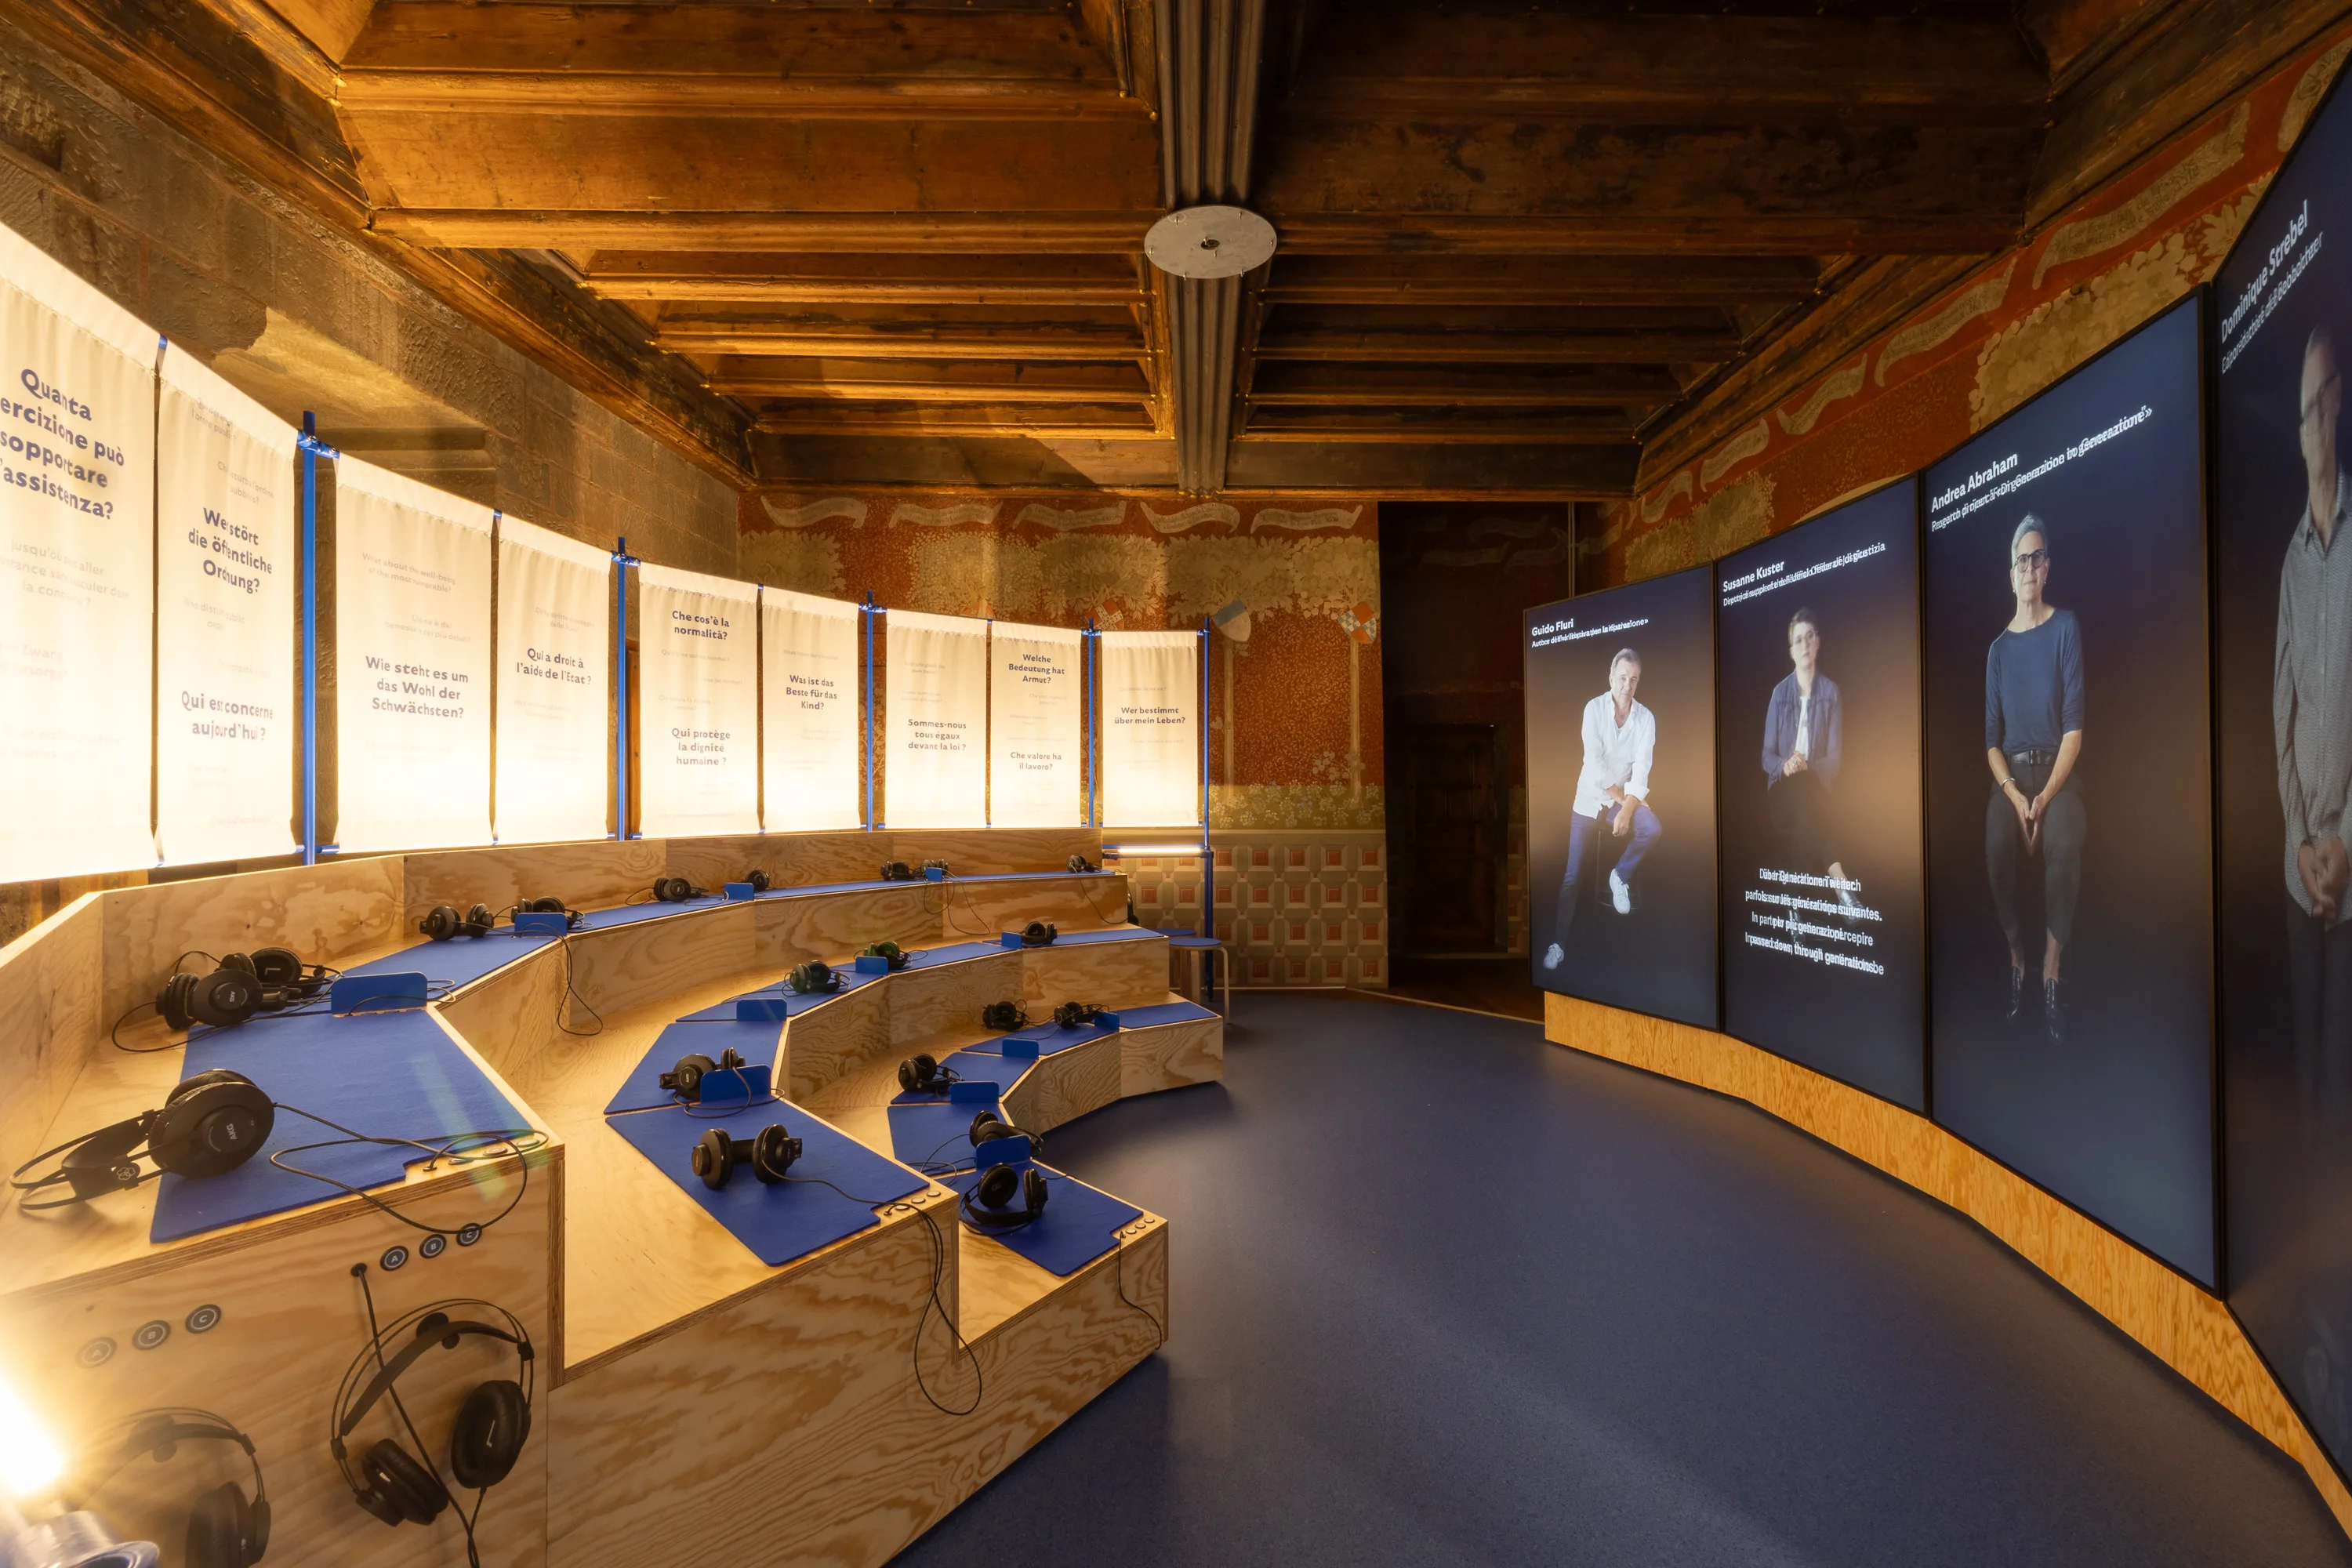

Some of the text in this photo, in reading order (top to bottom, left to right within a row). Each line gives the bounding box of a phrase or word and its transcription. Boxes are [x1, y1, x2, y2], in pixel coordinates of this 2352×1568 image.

[2222, 266, 2268, 343] Dominique
[2268, 199, 2308, 275] Strebel
[21, 368, 92, 421] Quanta
[0, 397, 125, 466] ercizione può
[1931, 453, 2018, 513] Andrea Abraham
[188, 528, 208, 548] die
[230, 524, 259, 546] stört
[383, 560, 408, 571] about
[391, 574, 412, 583] most
[1723, 561, 1784, 593] Susanne Kuster
[672, 611, 729, 627] Che cos'è la
[674, 627, 728, 640] normalità?
[1532, 624, 1555, 636] Guido
[1555, 619, 1574, 631] Fluri
[528, 648, 543, 661] Qui
[554, 654, 575, 666] droit
[579, 659, 584, 668] à
[1022, 654, 1051, 662] Welche
[365, 656, 468, 683] Wie steht es um
[517, 662, 543, 677] l'aide
[546, 668, 558, 679] de
[588, 676, 591, 685] ?
[1008, 663, 1051, 674] Bedeutung
[789, 674, 806, 684] Was
[1022, 675, 1051, 684] Armut?
[377, 678, 460, 699] das Wohl der
[786, 687, 808, 696] Beste
[825, 691, 837, 699] das
[182, 691, 205, 711] Qui
[372, 697, 464, 718] Schwächsten?
[801, 701, 824, 710] Kind?
[908, 719, 967, 728] Sommes-nous
[672, 728, 731, 741] Qui protège
[935, 731, 960, 740] égaux
[678, 742, 724, 753] la dignité
[676, 756, 719, 765] humaine
[226, 1123, 238, 1141] AKG
